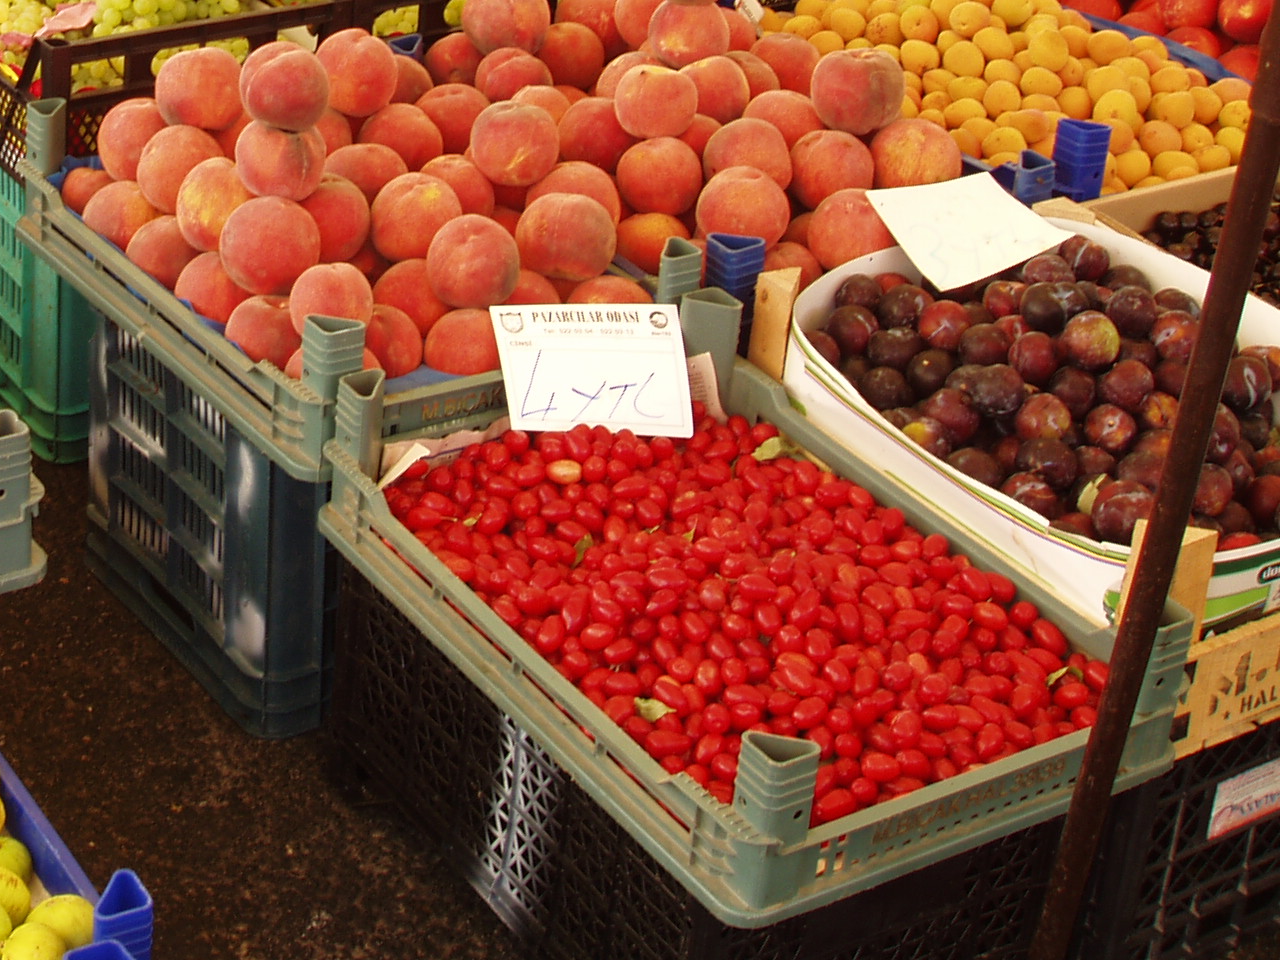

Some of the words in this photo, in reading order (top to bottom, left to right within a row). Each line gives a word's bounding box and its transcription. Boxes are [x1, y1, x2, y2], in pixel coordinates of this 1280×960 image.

[531, 310, 604, 324] PAZARCILAR
[606, 310, 640, 324] ODASI
[521, 349, 558, 422] 4
[570, 372, 665, 423] YTL
[1240, 685, 1278, 714] HAL
